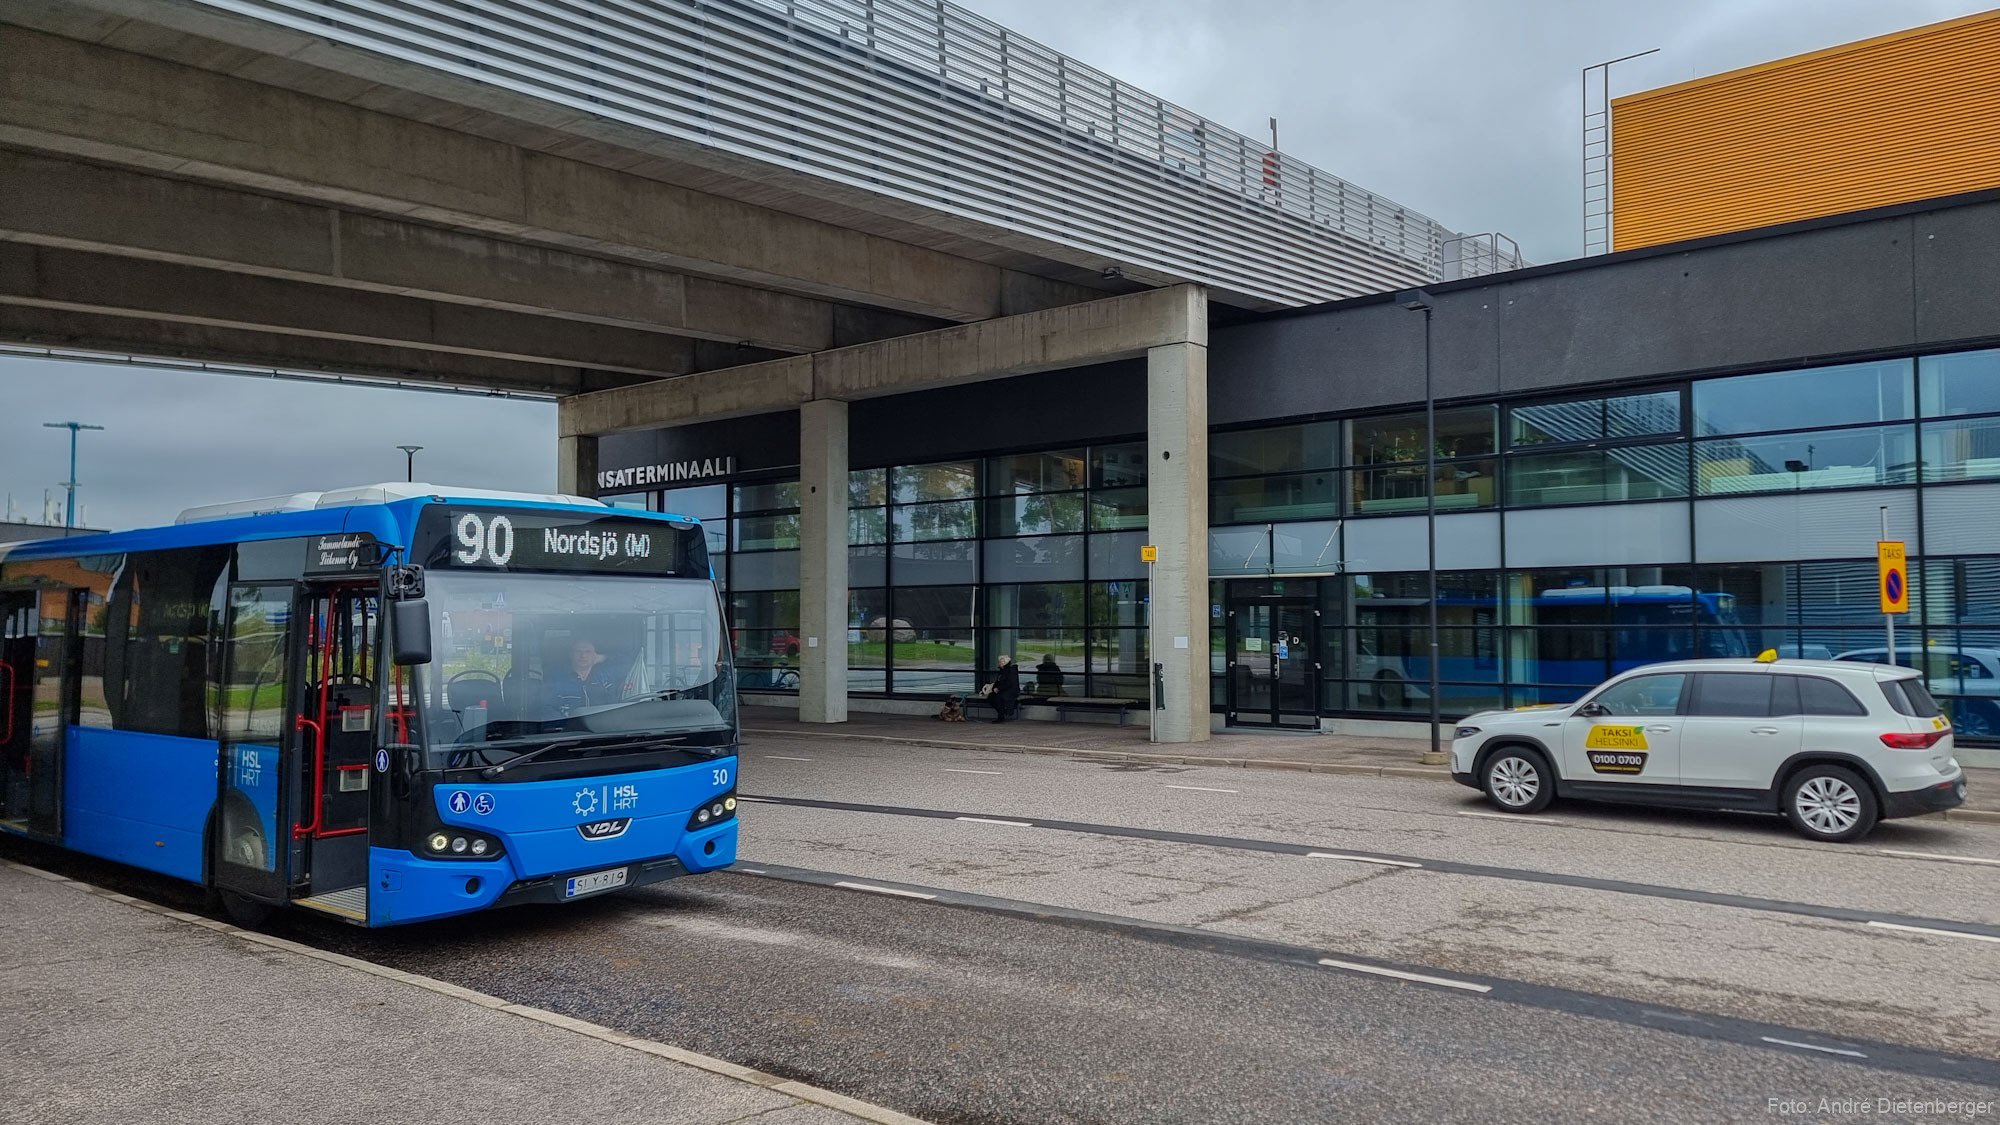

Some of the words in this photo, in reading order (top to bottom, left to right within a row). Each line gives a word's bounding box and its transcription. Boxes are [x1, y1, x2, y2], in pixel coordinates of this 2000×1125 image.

[457, 513, 514, 565] 90
[544, 528, 618, 561] Nordsjö
[625, 532, 651, 558] (M)
[348, 549, 359, 570] Oy
[1602, 728, 1632, 737] TAKSI
[1595, 737, 1639, 747] HELSINKI
[242, 750, 261, 769] HSL
[1594, 754, 1616, 764] 0100
[1618, 755, 1642, 765] 0700
[241, 768, 261, 787] HRT
[712, 768, 728, 786] 30
[613, 785, 639, 798] HSL
[613, 797, 639, 811] HRT
[586, 820, 622, 835] VDL
